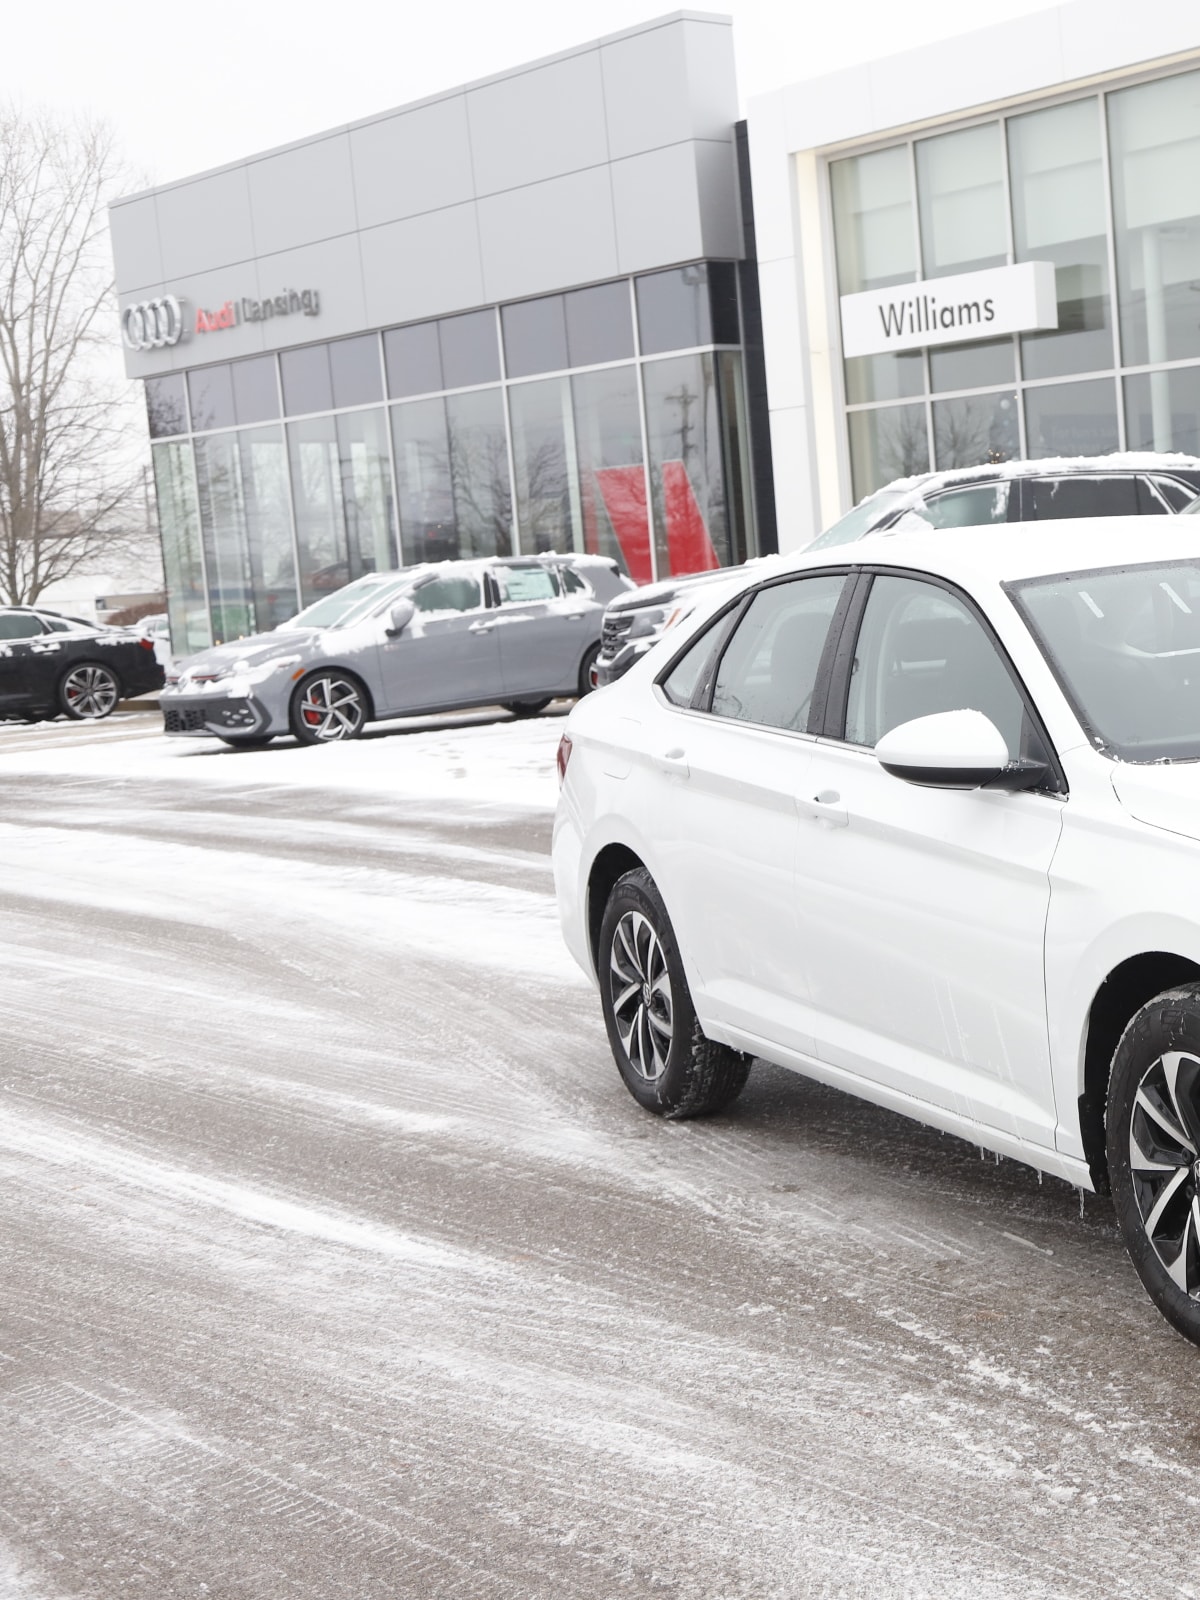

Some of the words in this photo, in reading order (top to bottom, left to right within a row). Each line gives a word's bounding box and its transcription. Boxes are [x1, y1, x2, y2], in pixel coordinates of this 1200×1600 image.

[195, 301, 235, 334] Audi
[242, 287, 321, 323] Lansing
[878, 295, 996, 338] Williams
